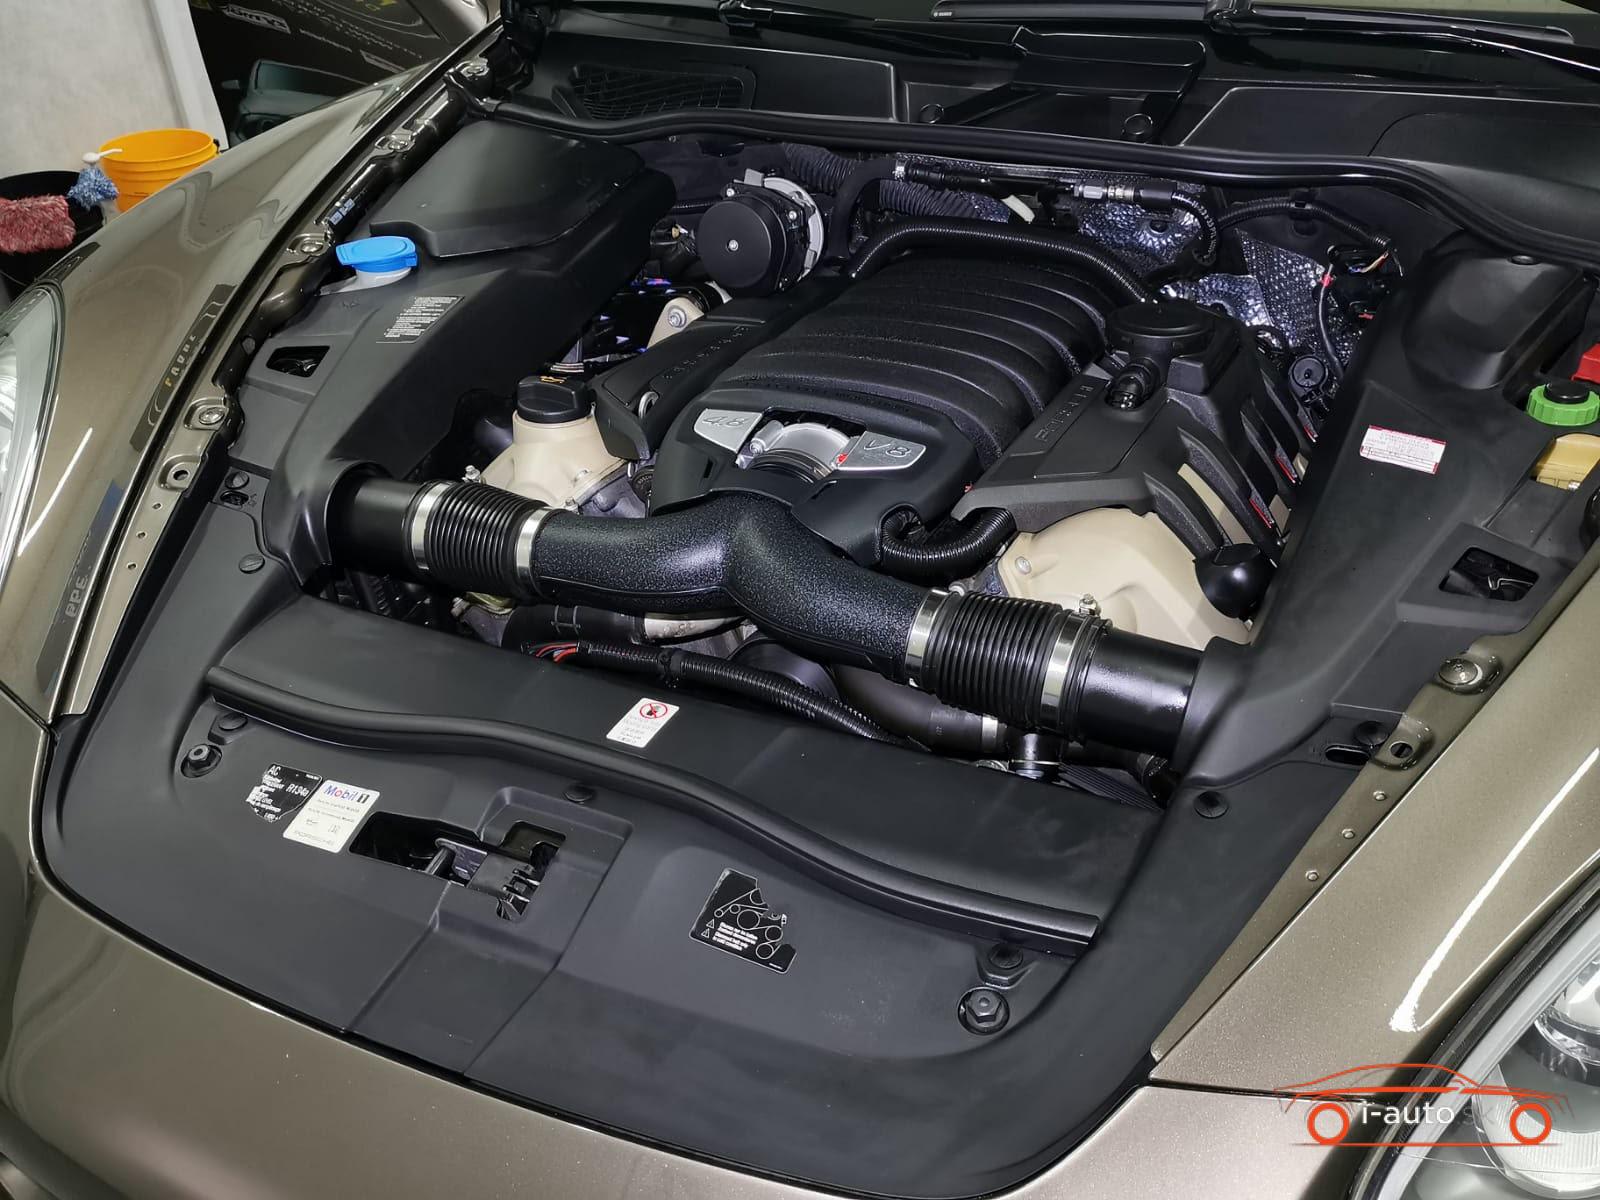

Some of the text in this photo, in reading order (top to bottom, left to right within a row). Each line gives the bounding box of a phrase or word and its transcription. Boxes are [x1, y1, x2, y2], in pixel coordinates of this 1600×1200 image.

[701, 414, 747, 428] 4.8
[863, 439, 911, 458] V8
[267, 765, 281, 776] AC
[323, 784, 359, 801] Mobil
